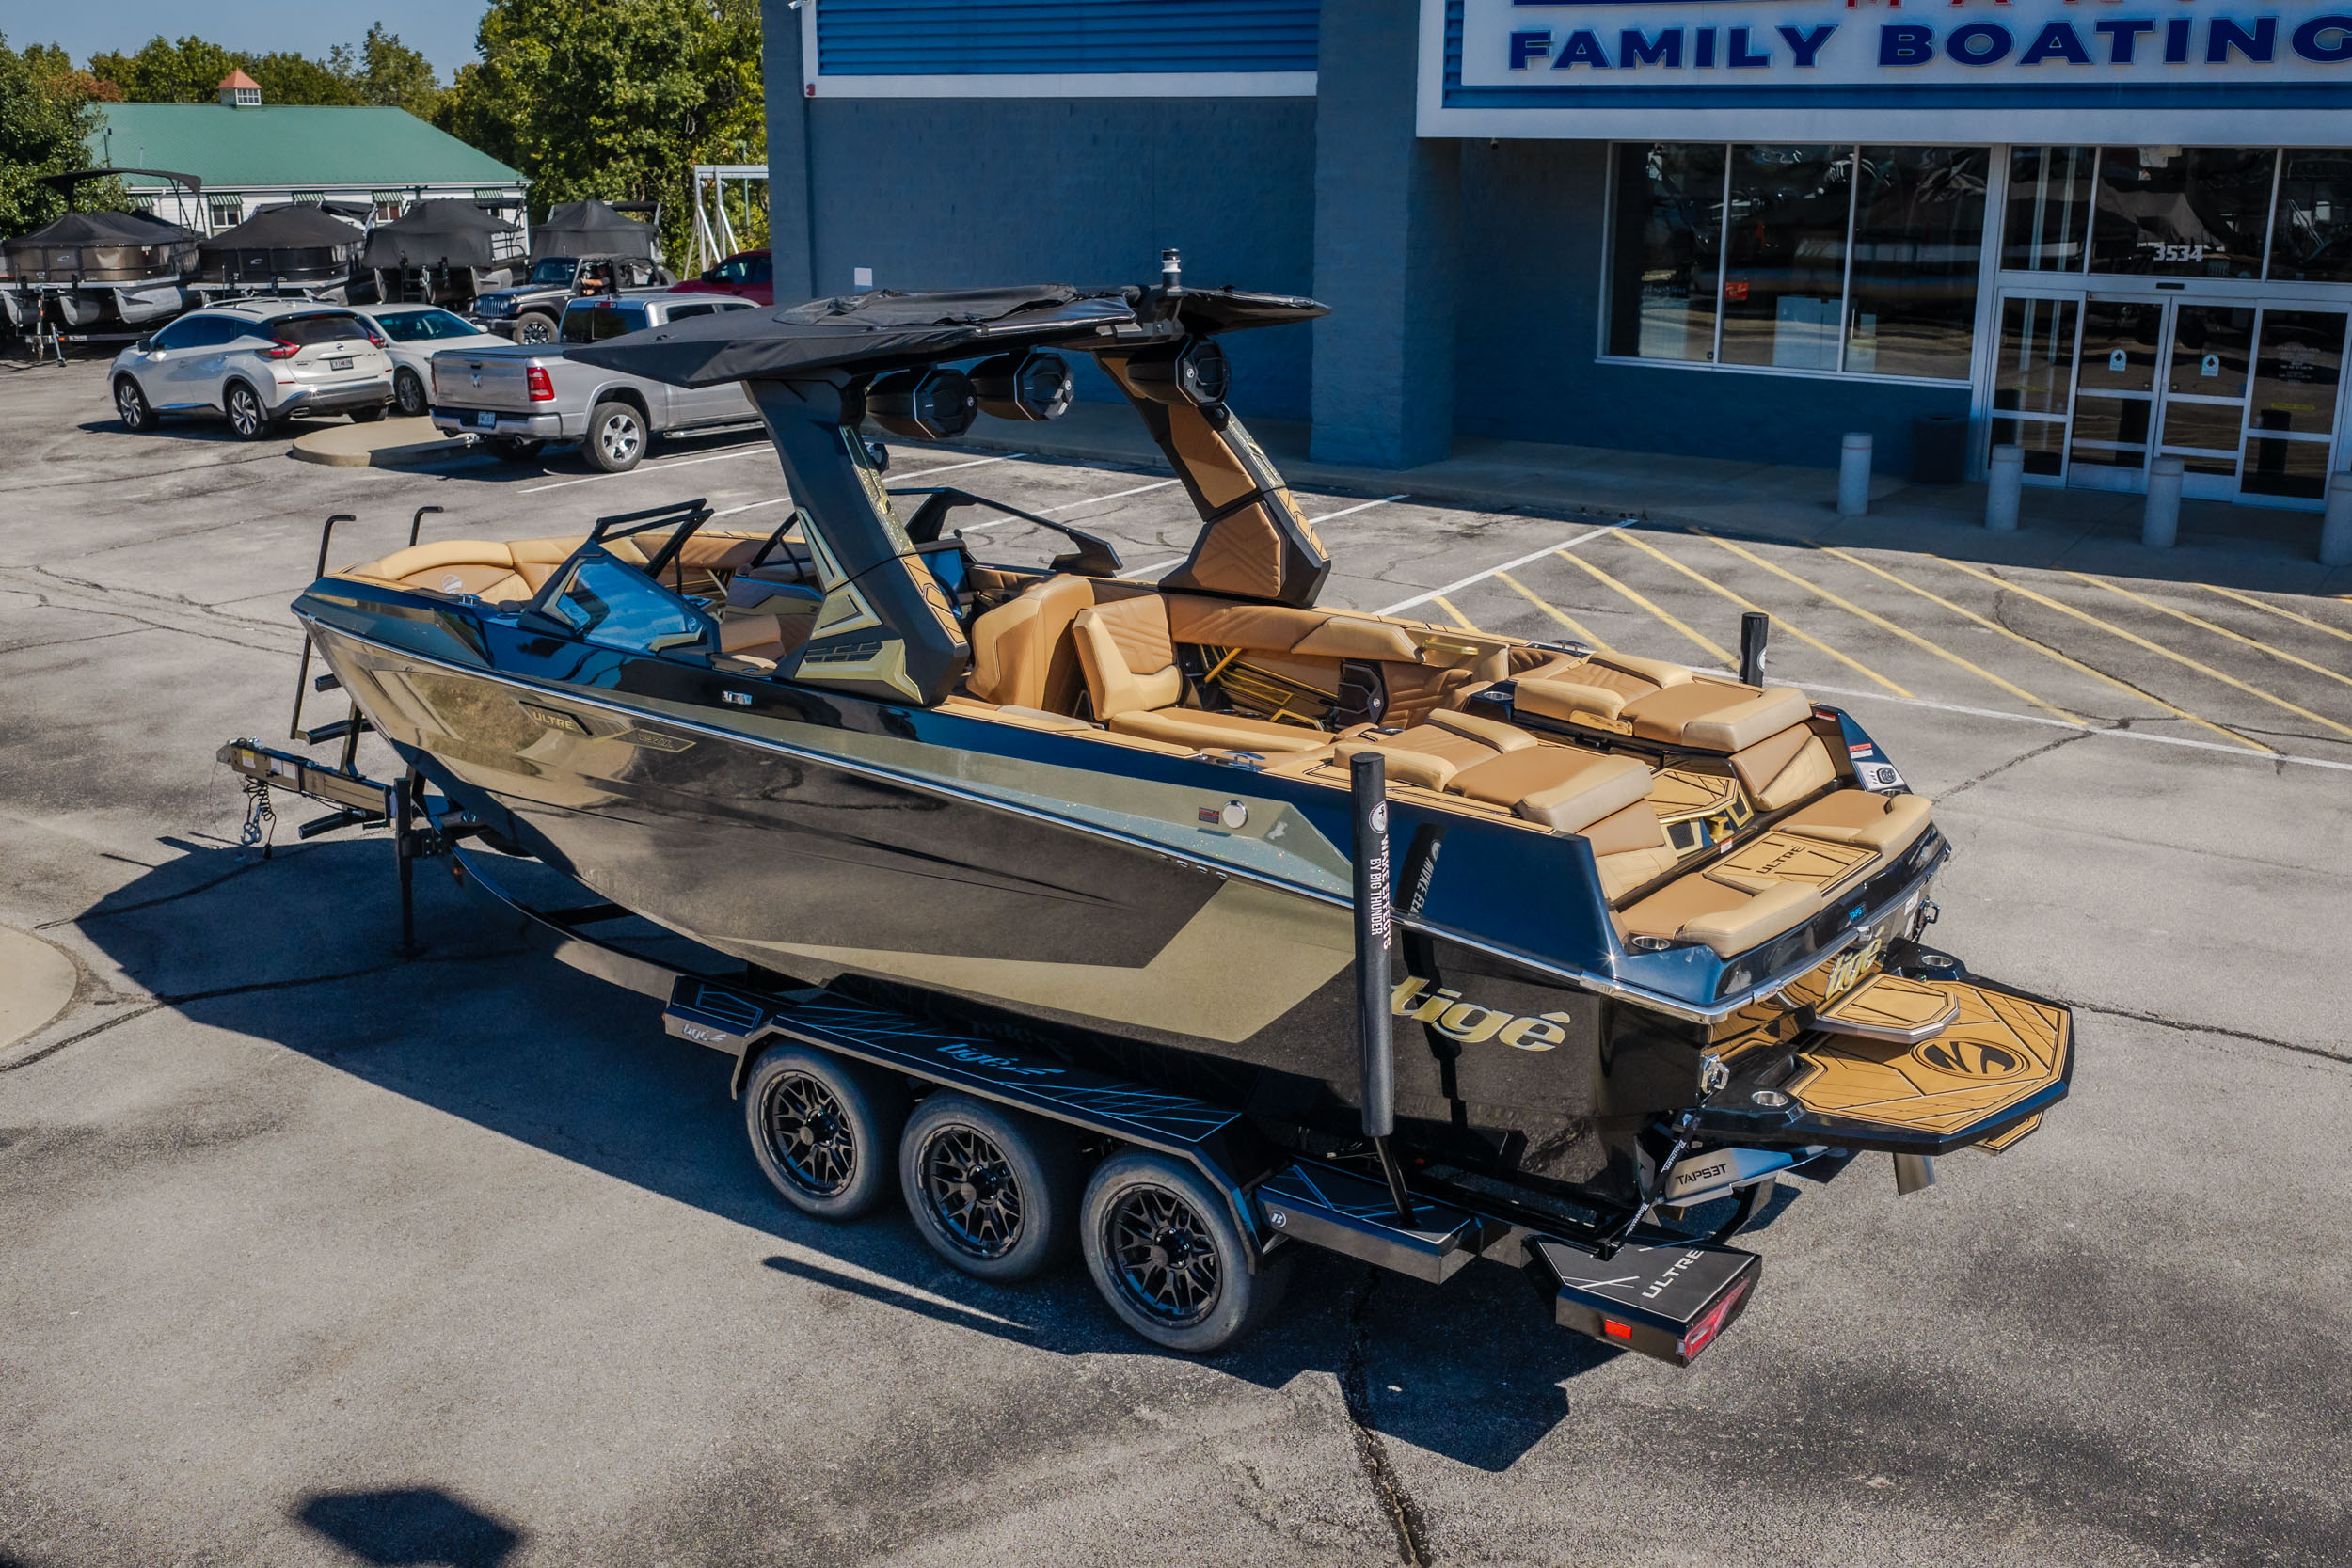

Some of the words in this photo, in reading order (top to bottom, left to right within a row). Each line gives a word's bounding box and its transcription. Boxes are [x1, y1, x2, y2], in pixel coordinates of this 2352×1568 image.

[1509, 24, 1839, 71] FAMILY
[1877, 15, 2352, 67] BOATING
[2153, 242, 2203, 262] 3534
[1370, 858, 1382, 871] BY
[1370, 873, 1382, 889] BIG
[1370, 892, 1383, 936] THUNDER
